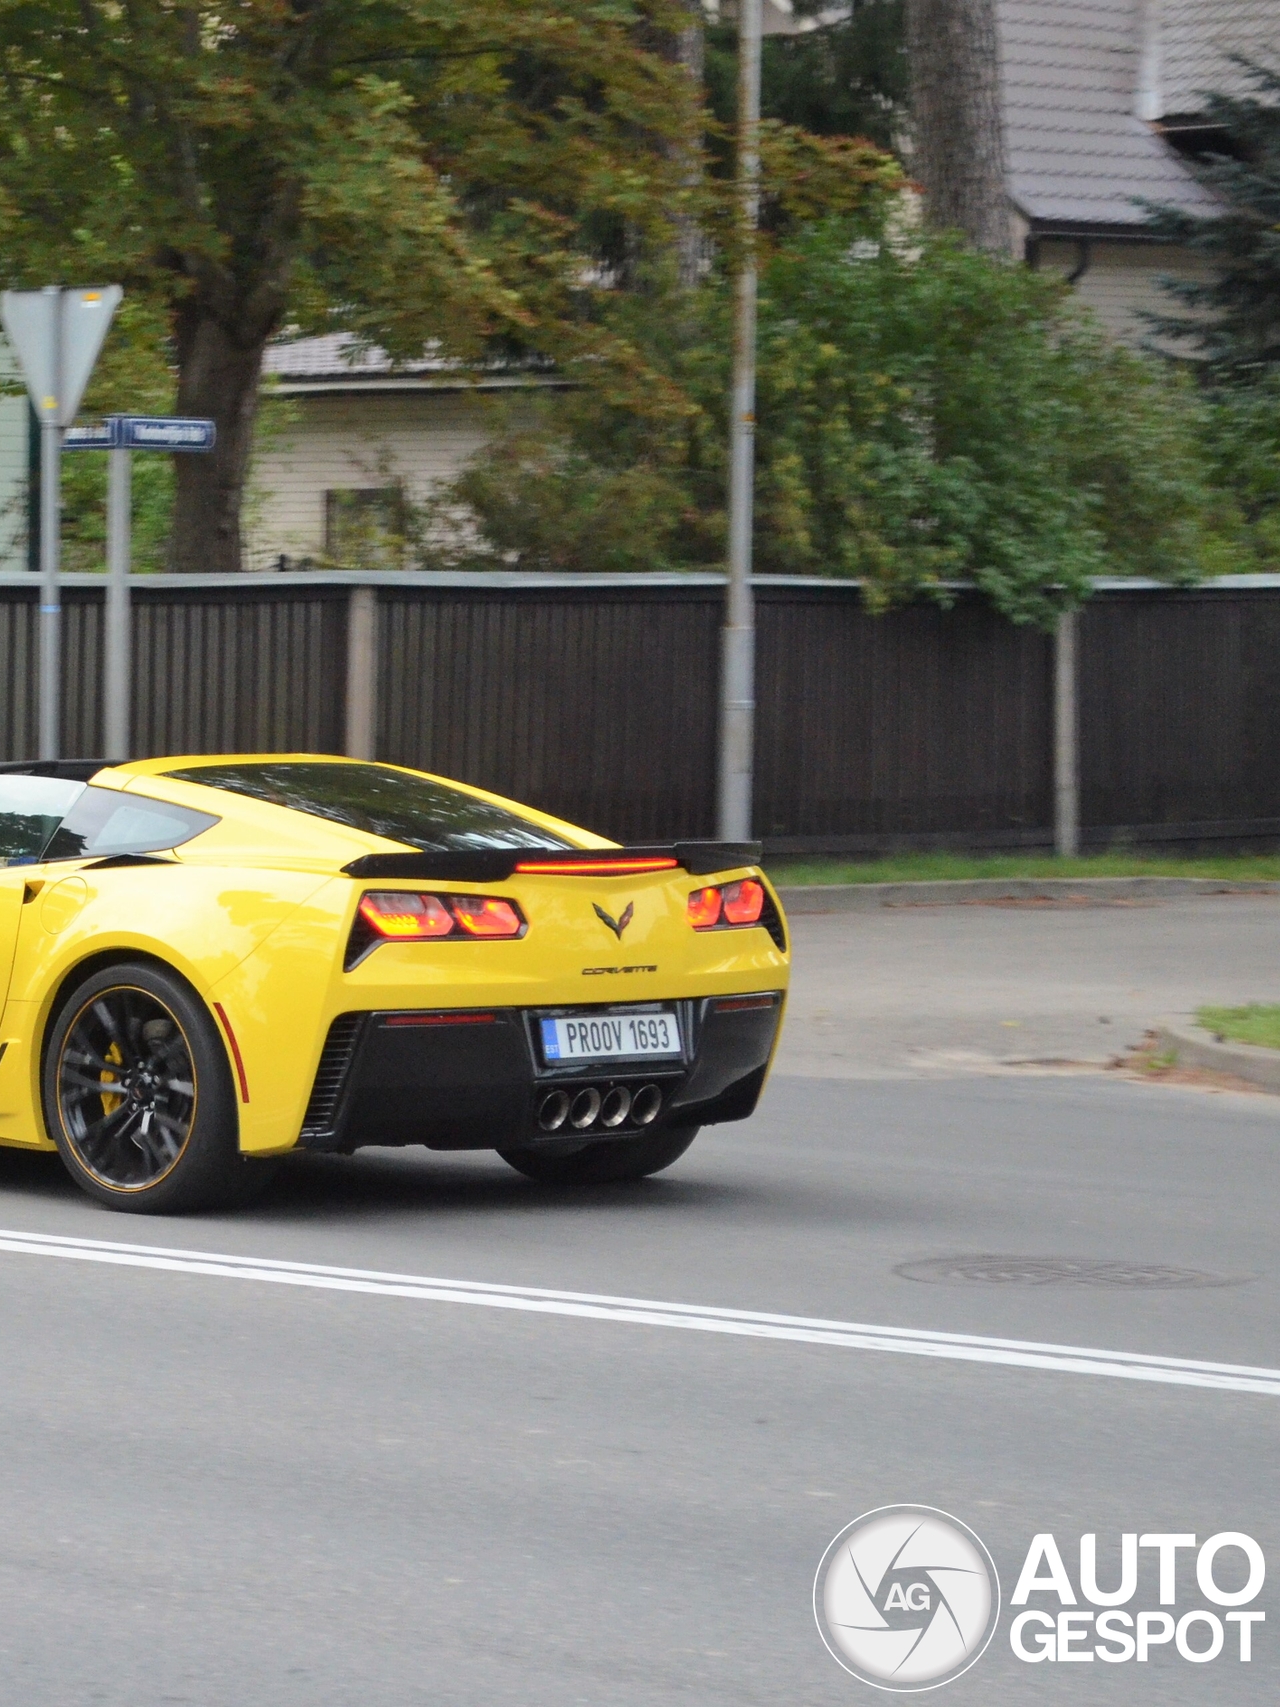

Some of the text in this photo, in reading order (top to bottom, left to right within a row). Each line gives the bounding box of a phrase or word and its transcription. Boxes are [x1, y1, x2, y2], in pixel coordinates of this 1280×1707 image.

[582, 965, 658, 975] CORVETTE
[629, 1019, 670, 1050] 1693
[545, 1044, 559, 1054] EST
